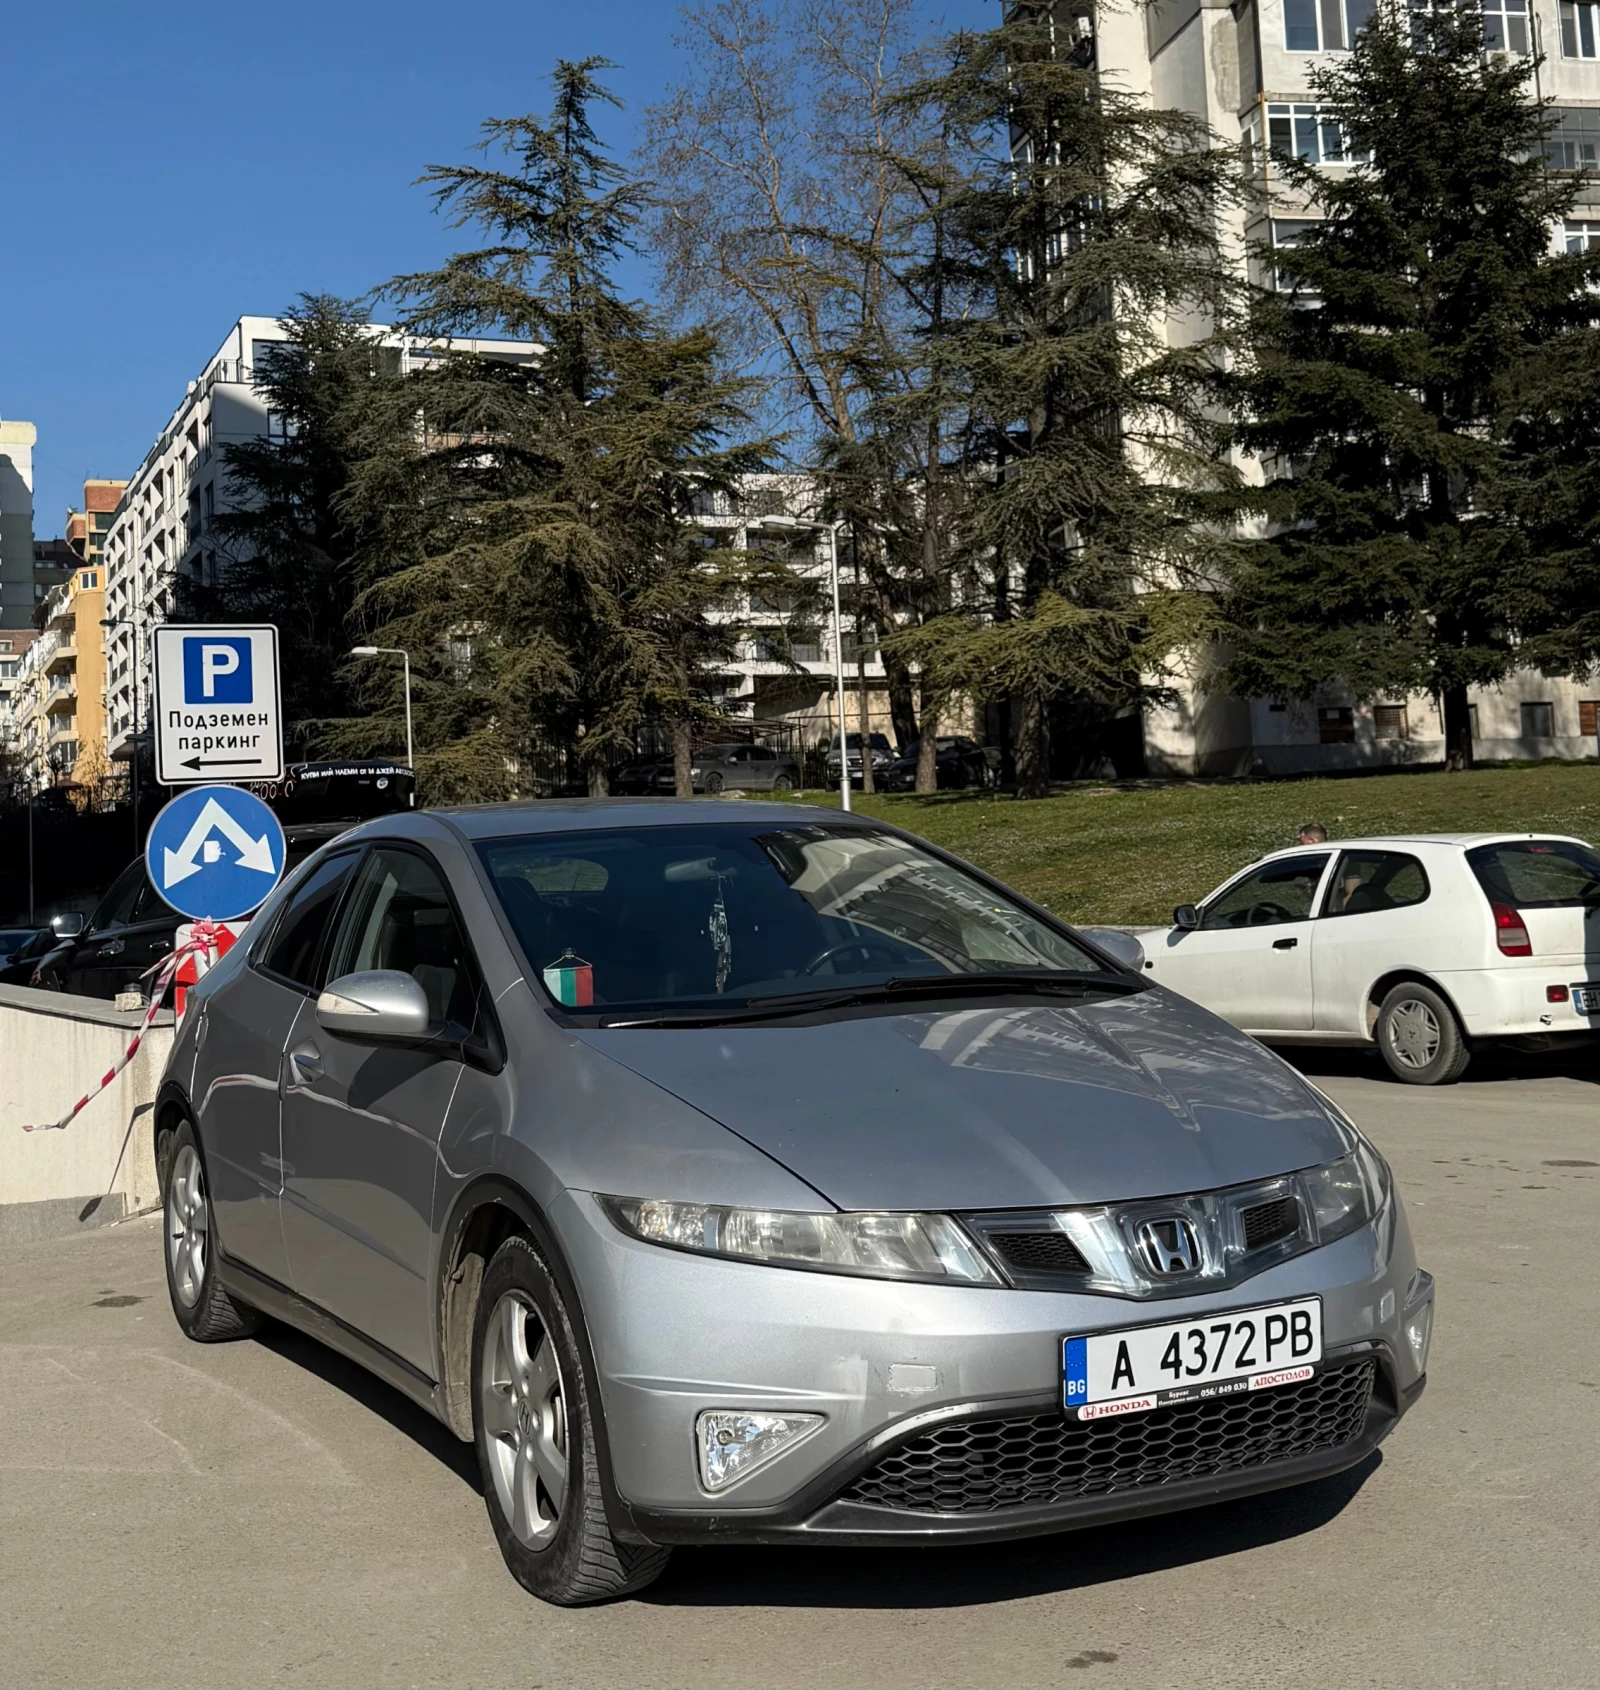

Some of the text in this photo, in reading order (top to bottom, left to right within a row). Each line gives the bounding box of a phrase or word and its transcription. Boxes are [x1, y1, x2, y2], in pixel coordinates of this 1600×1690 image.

[202, 644, 240, 697] P
[169, 710, 269, 731] Подземен
[178, 733, 261, 754] паркинг
[301, 771, 319, 780] КУПИ
[1111, 1340, 1136, 1391] A
[1067, 1379, 1086, 1396] BG
[1253, 1368, 1311, 1388] АПОСТОЛОВ
[1099, 1399, 1151, 1416] HONDA
